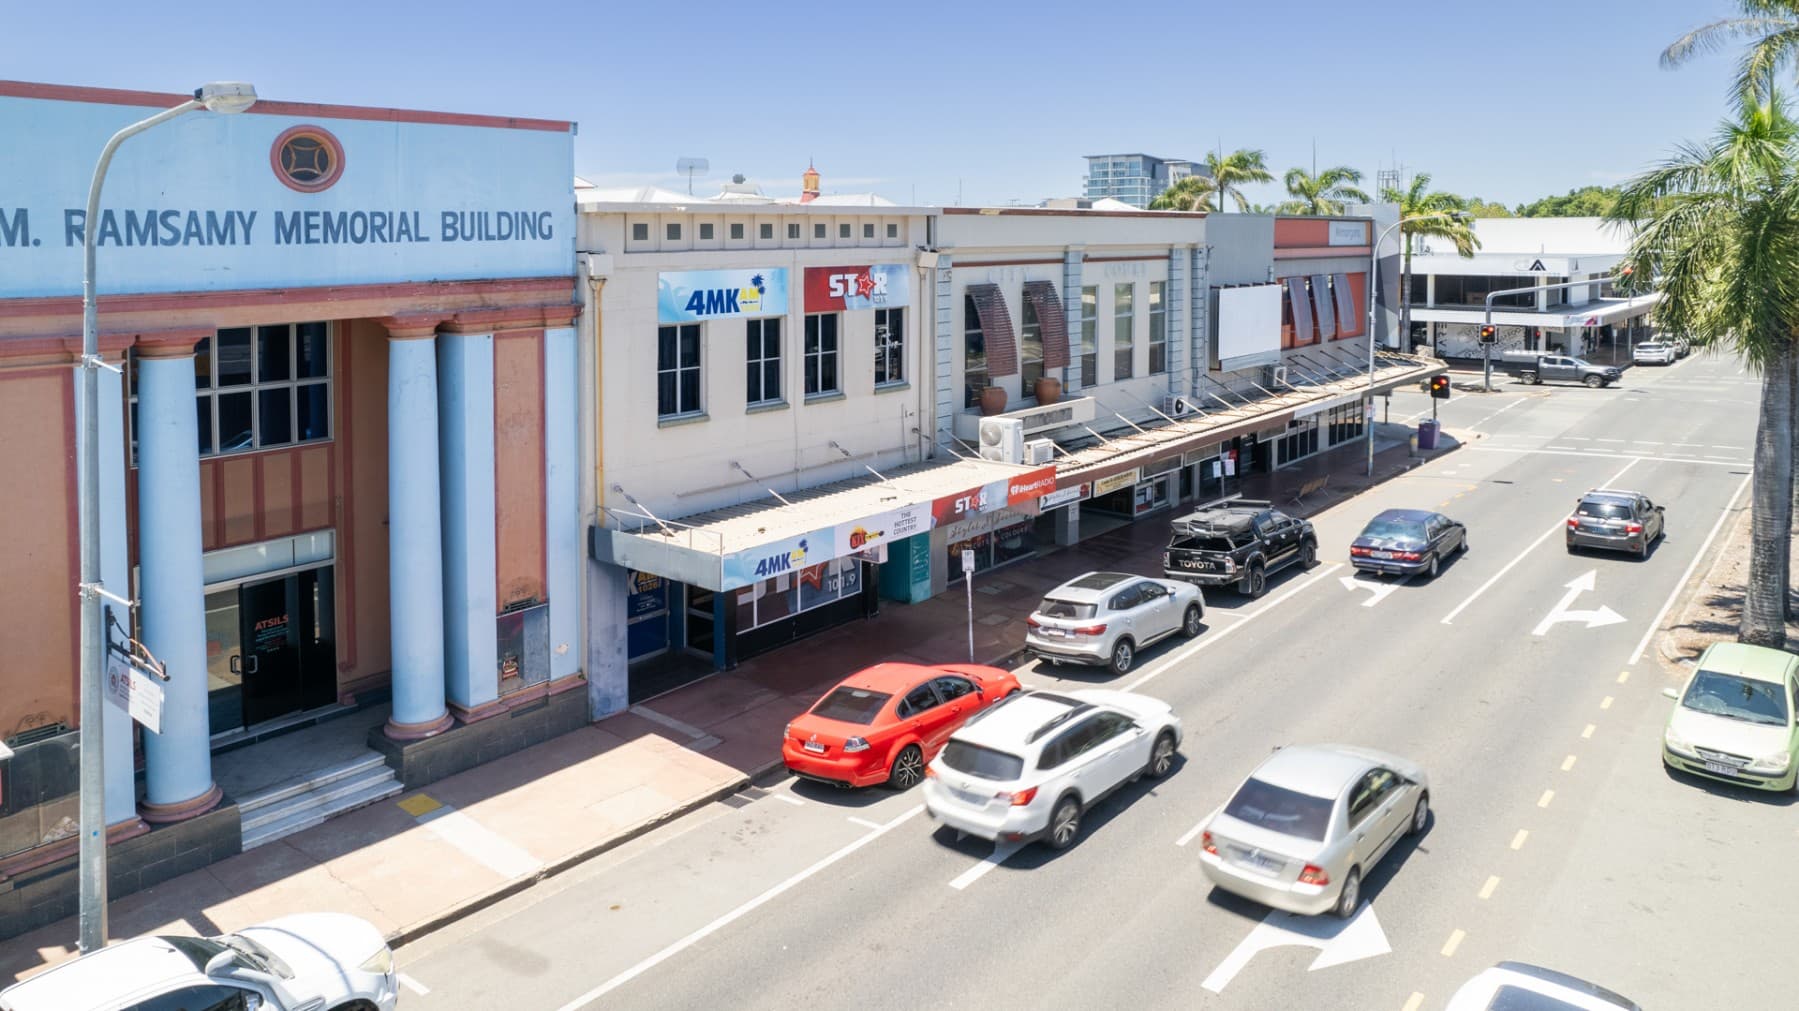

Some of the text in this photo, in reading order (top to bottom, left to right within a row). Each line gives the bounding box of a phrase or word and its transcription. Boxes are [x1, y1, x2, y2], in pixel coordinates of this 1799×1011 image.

[64, 209, 257, 247] RAMSAMY
[274, 211, 430, 245] MEMORIAL
[441, 211, 553, 242] BUILDING
[685, 288, 740, 315] 4MK
[894, 516, 917, 528] HOTTEST
[901, 511, 911, 519] THE
[893, 525, 916, 535] COUNTRY
[755, 552, 791, 576] 4MK
[1179, 559, 1216, 570] TOYOTA
[828, 577, 856, 593] 101.9
[255, 614, 289, 631] ATSILS
